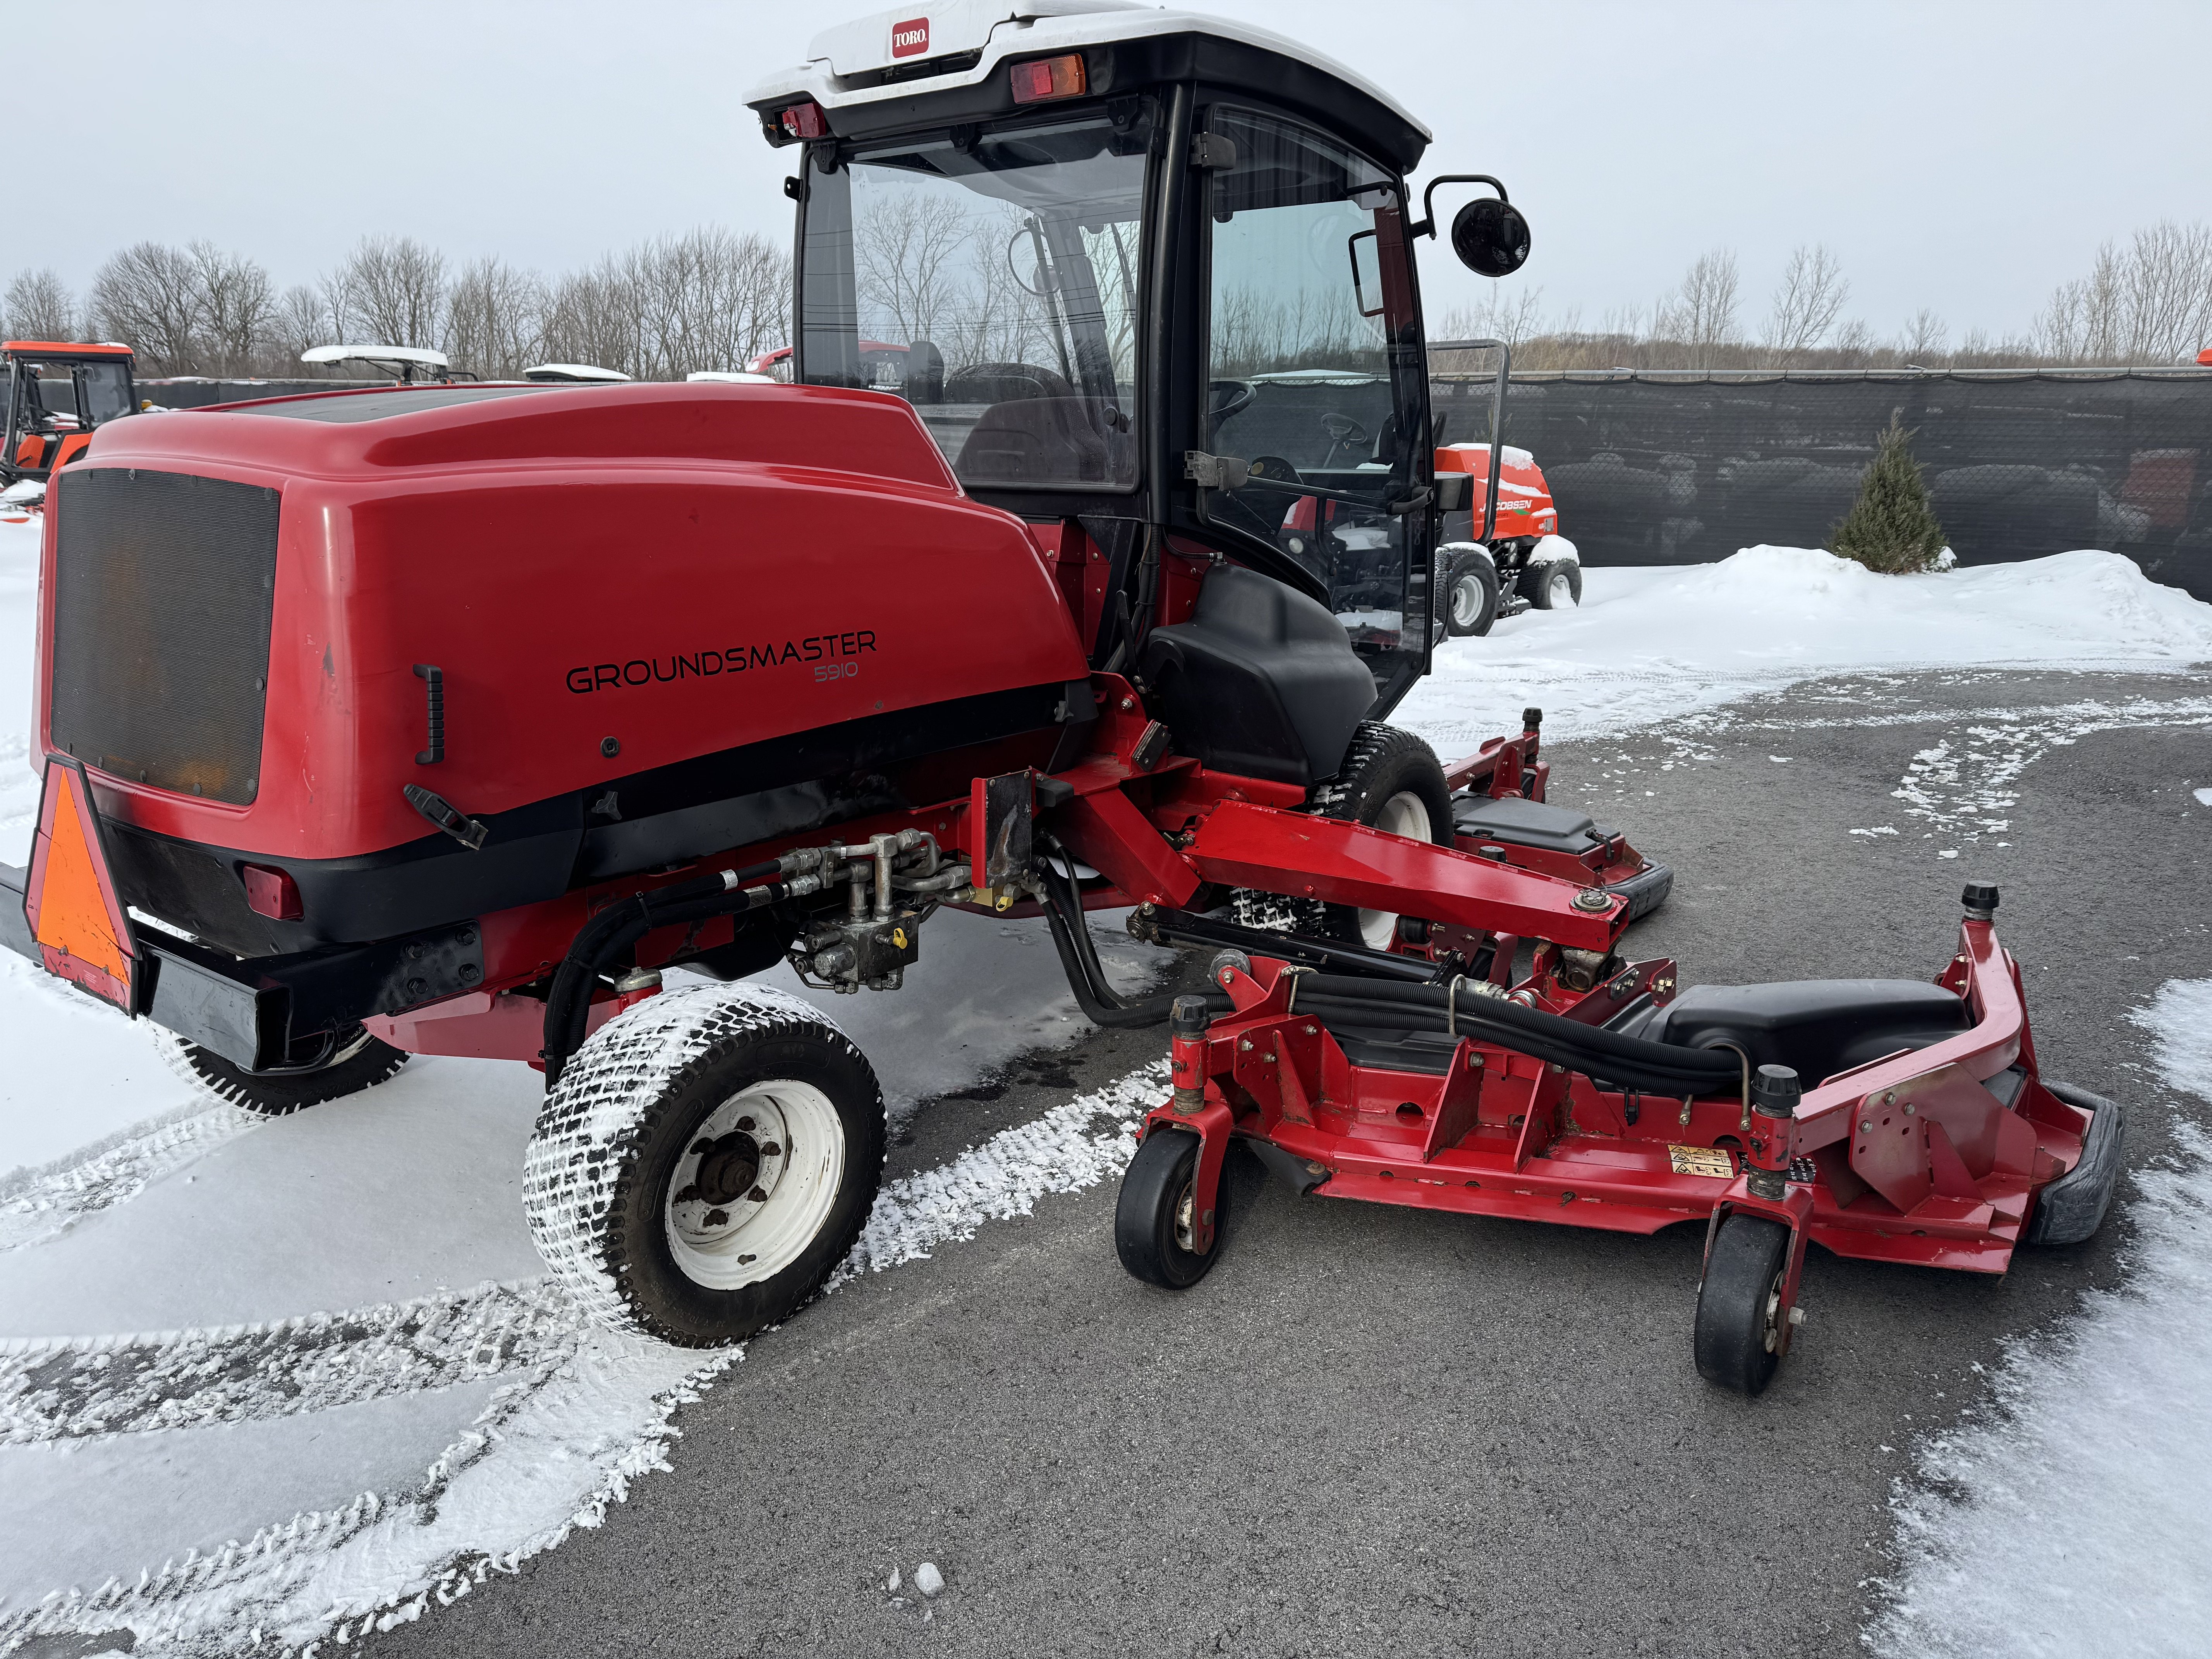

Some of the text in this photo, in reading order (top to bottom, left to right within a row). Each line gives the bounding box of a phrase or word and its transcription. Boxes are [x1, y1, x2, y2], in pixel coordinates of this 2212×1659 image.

[894, 28, 927, 47] TORO
[1479, 499, 1533, 512] JCOBSEN
[566, 630, 877, 694] GROUNDSMASTER
[814, 661, 859, 683] 5910
[642, 1106, 695, 1210] CARLISLE
